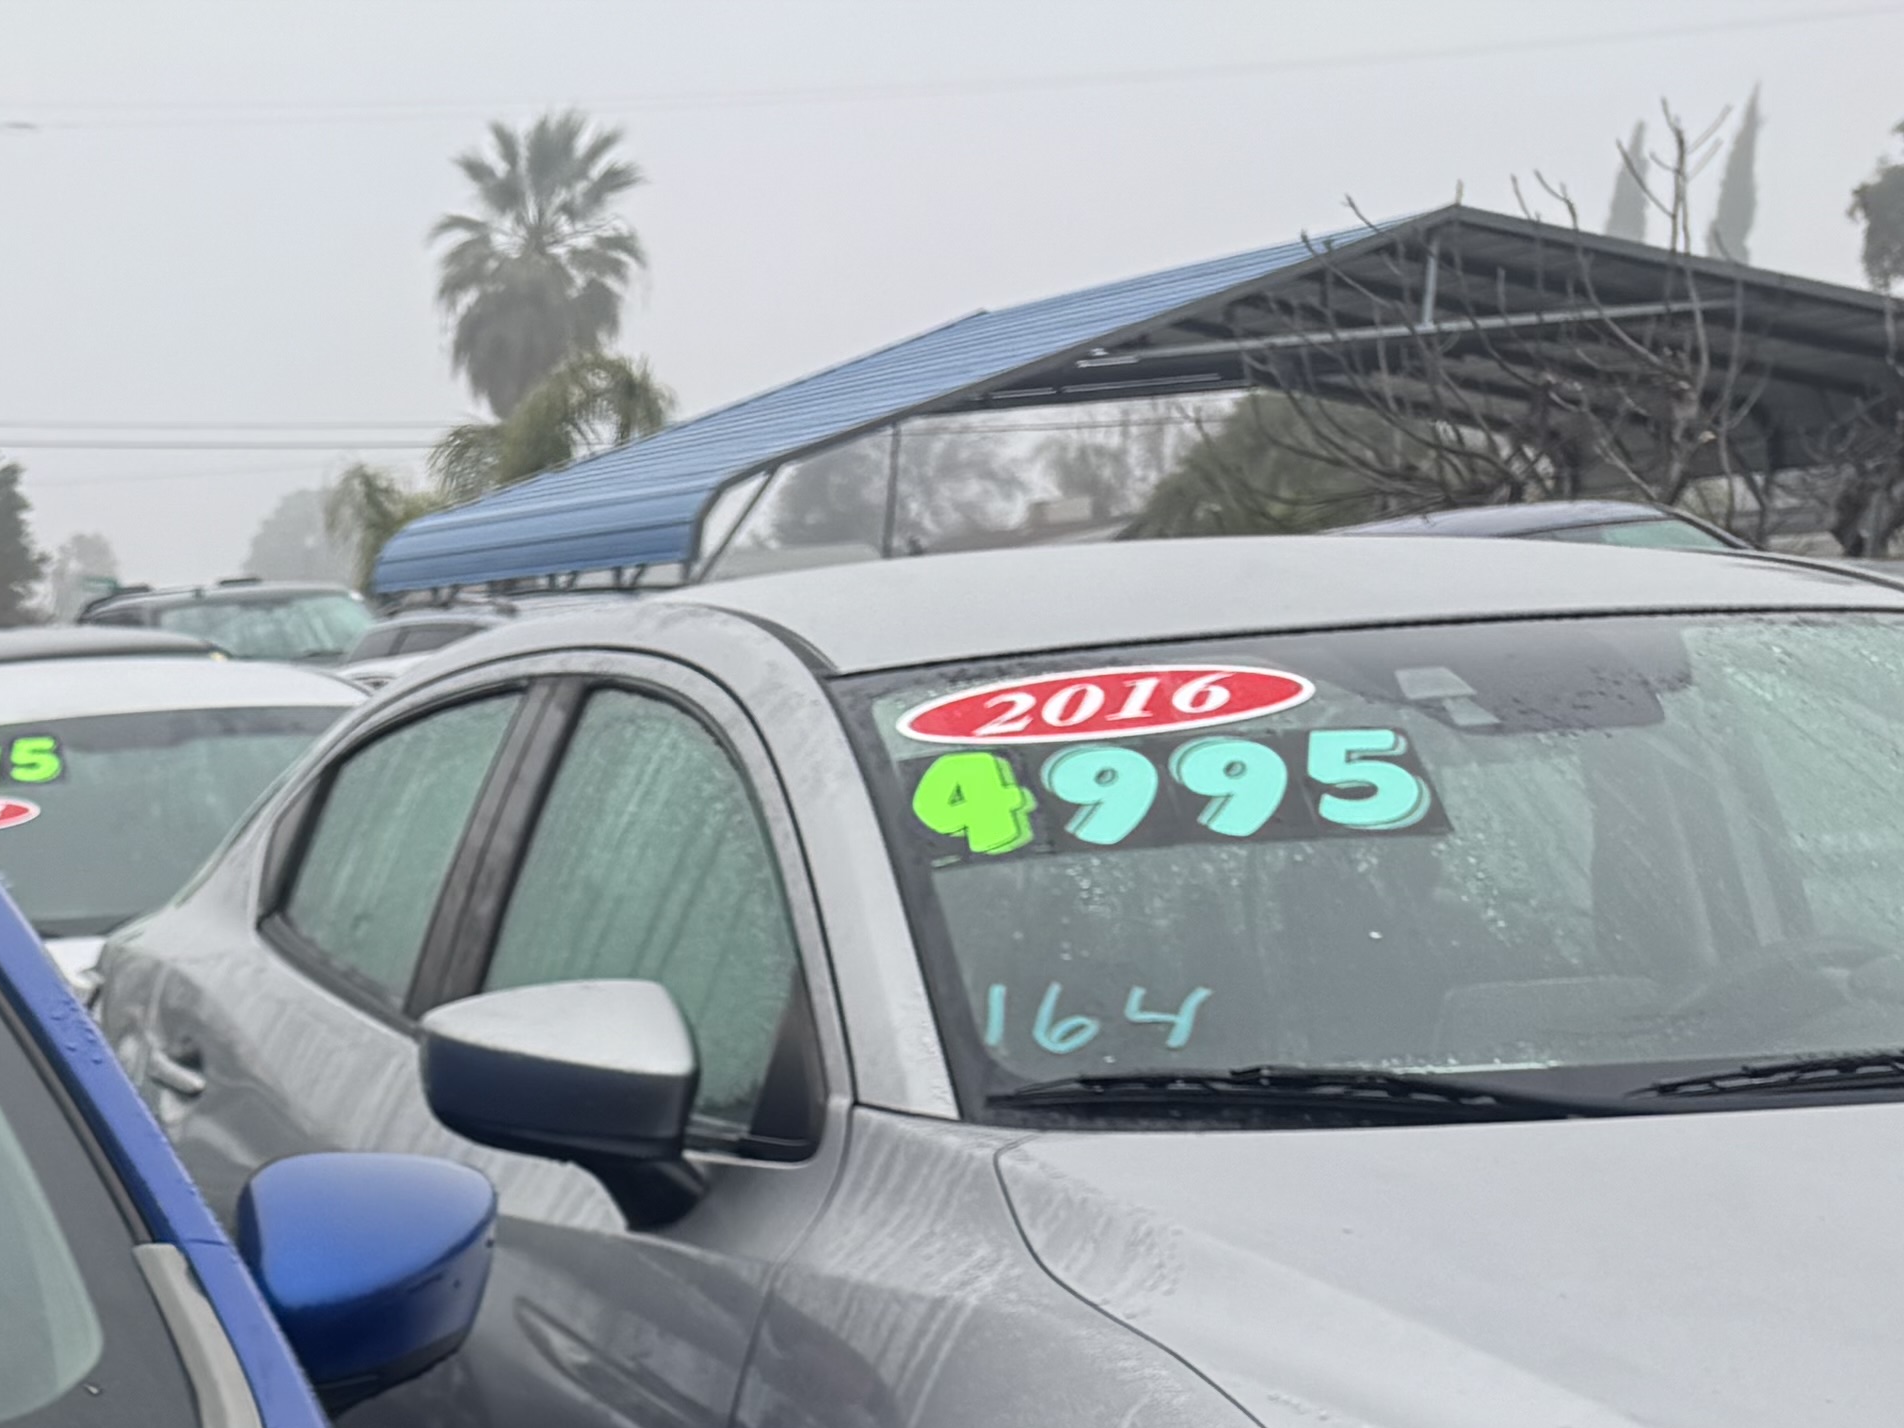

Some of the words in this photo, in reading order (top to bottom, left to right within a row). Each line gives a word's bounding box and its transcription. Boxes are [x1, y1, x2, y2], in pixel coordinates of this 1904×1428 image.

[973, 672, 1236, 736] 2016
[912, 729, 1430, 853] 4995
[986, 985, 1211, 1053] 164
